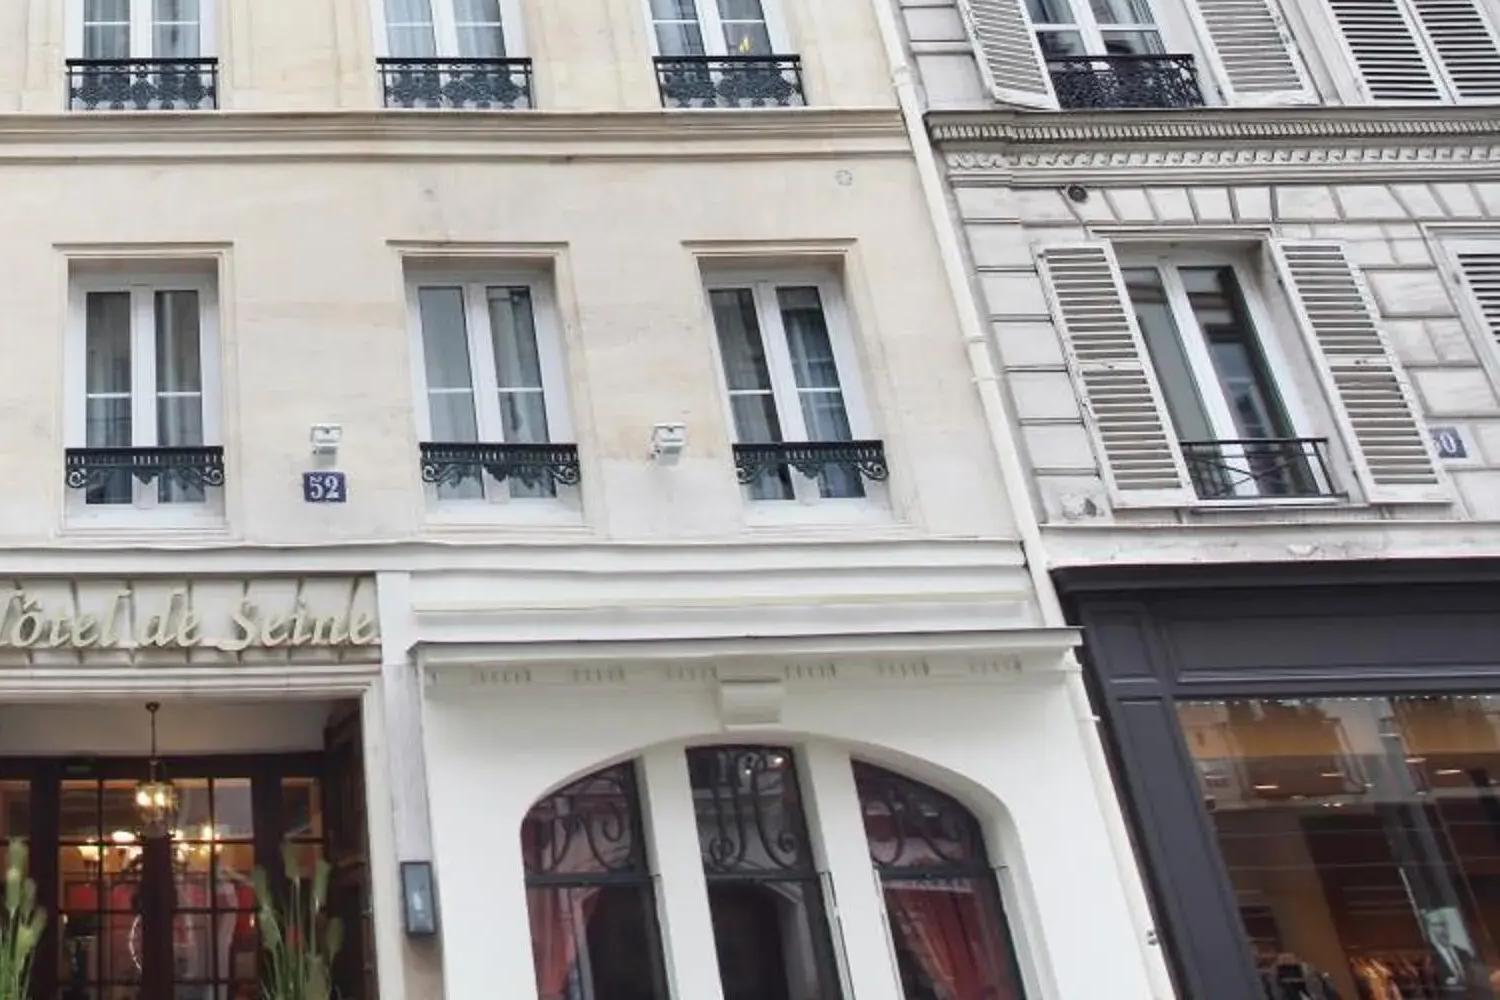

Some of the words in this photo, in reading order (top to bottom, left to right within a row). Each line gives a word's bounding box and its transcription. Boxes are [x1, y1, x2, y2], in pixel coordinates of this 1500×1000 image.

[308, 475, 341, 500] 52
[138, 588, 202, 648] de
[216, 597, 377, 651] Seine
